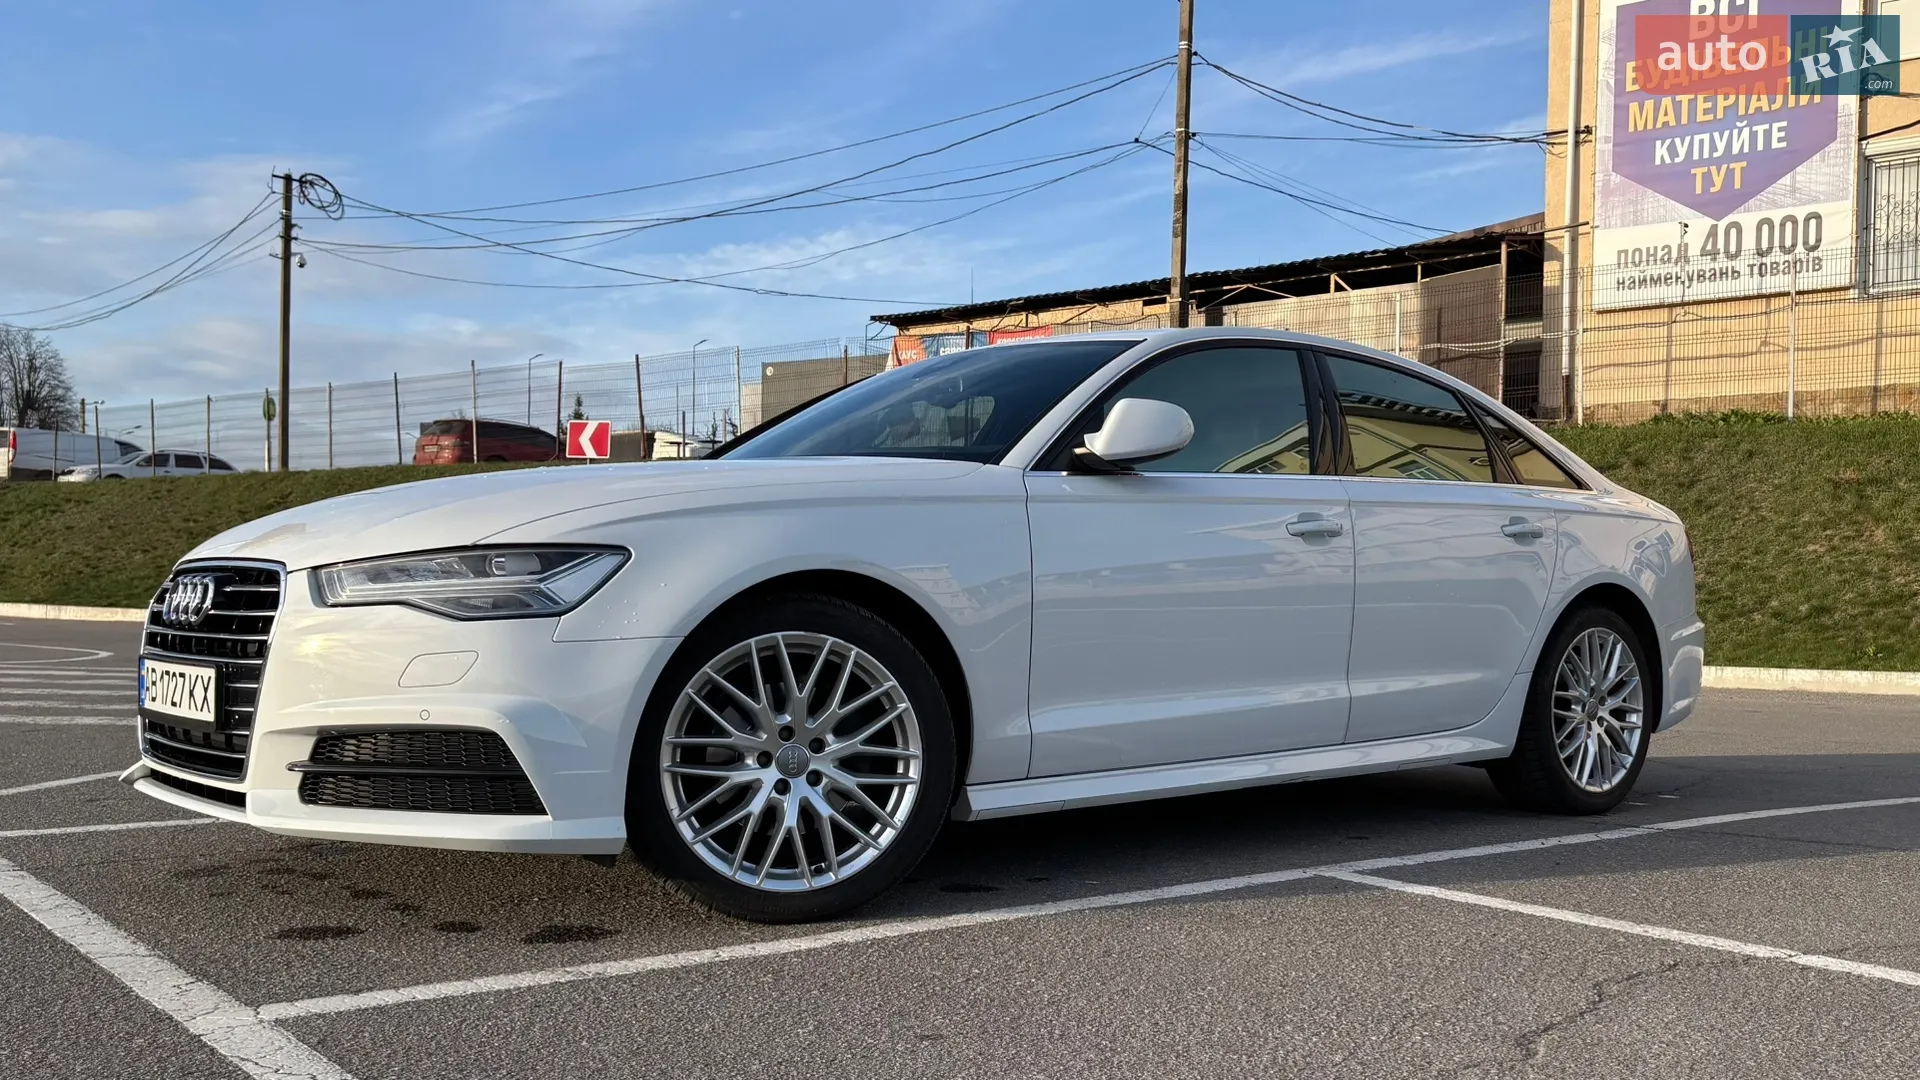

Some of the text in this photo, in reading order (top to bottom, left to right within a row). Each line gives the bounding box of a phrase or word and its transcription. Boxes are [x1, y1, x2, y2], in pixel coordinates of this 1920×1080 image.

[1628, 74, 1822, 132] МАТЕРІАЛИ
[1655, 121, 1788, 165] КУПУЙТЕ
[1691, 161, 1747, 195] ТУТ
[1616, 211, 1823, 269] понад 40 000
[1616, 252, 1823, 292] найменувань товарів
